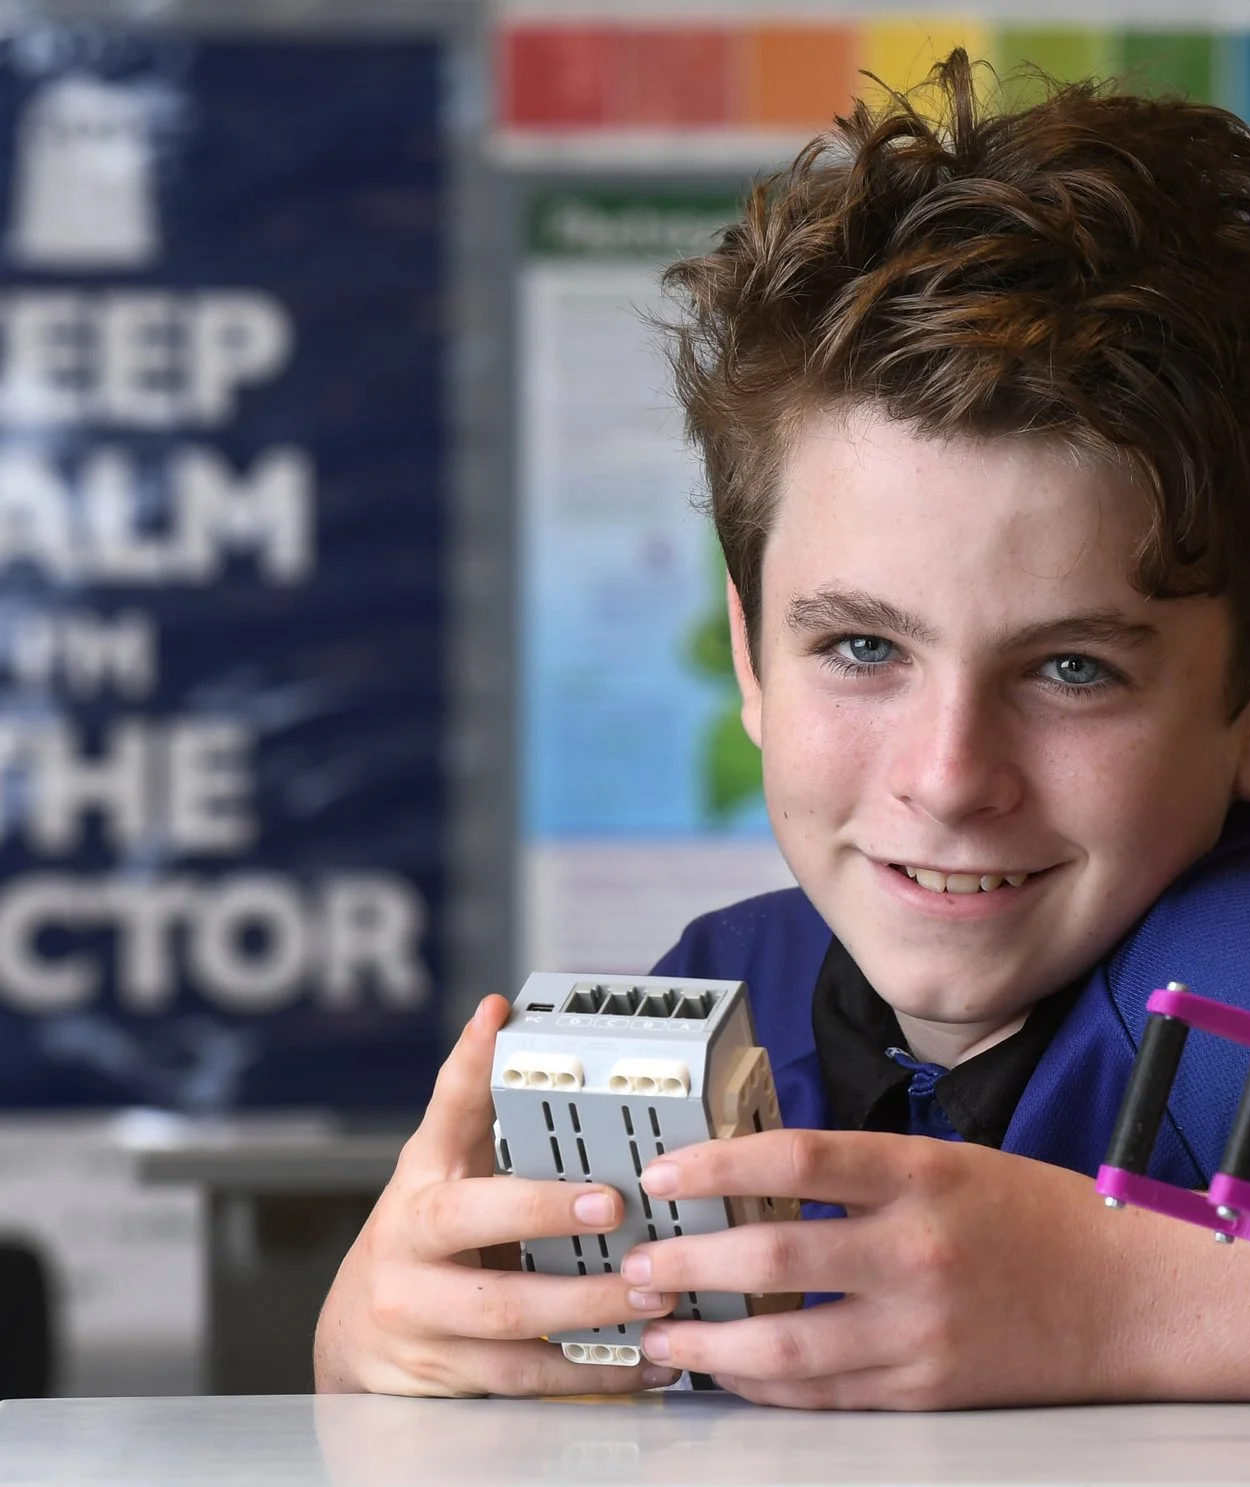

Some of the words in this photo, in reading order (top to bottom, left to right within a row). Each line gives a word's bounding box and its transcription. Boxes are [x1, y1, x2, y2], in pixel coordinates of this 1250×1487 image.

[0, 290, 291, 422] EEP
[0, 452, 313, 582] ALM
[0, 874, 424, 1006] CTOR
[524, 1015, 543, 1024] PC
[570, 1018, 580, 1026] D
[606, 1019, 618, 1027] C
[643, 1021, 654, 1029] B
[679, 1023, 691, 1031] A
